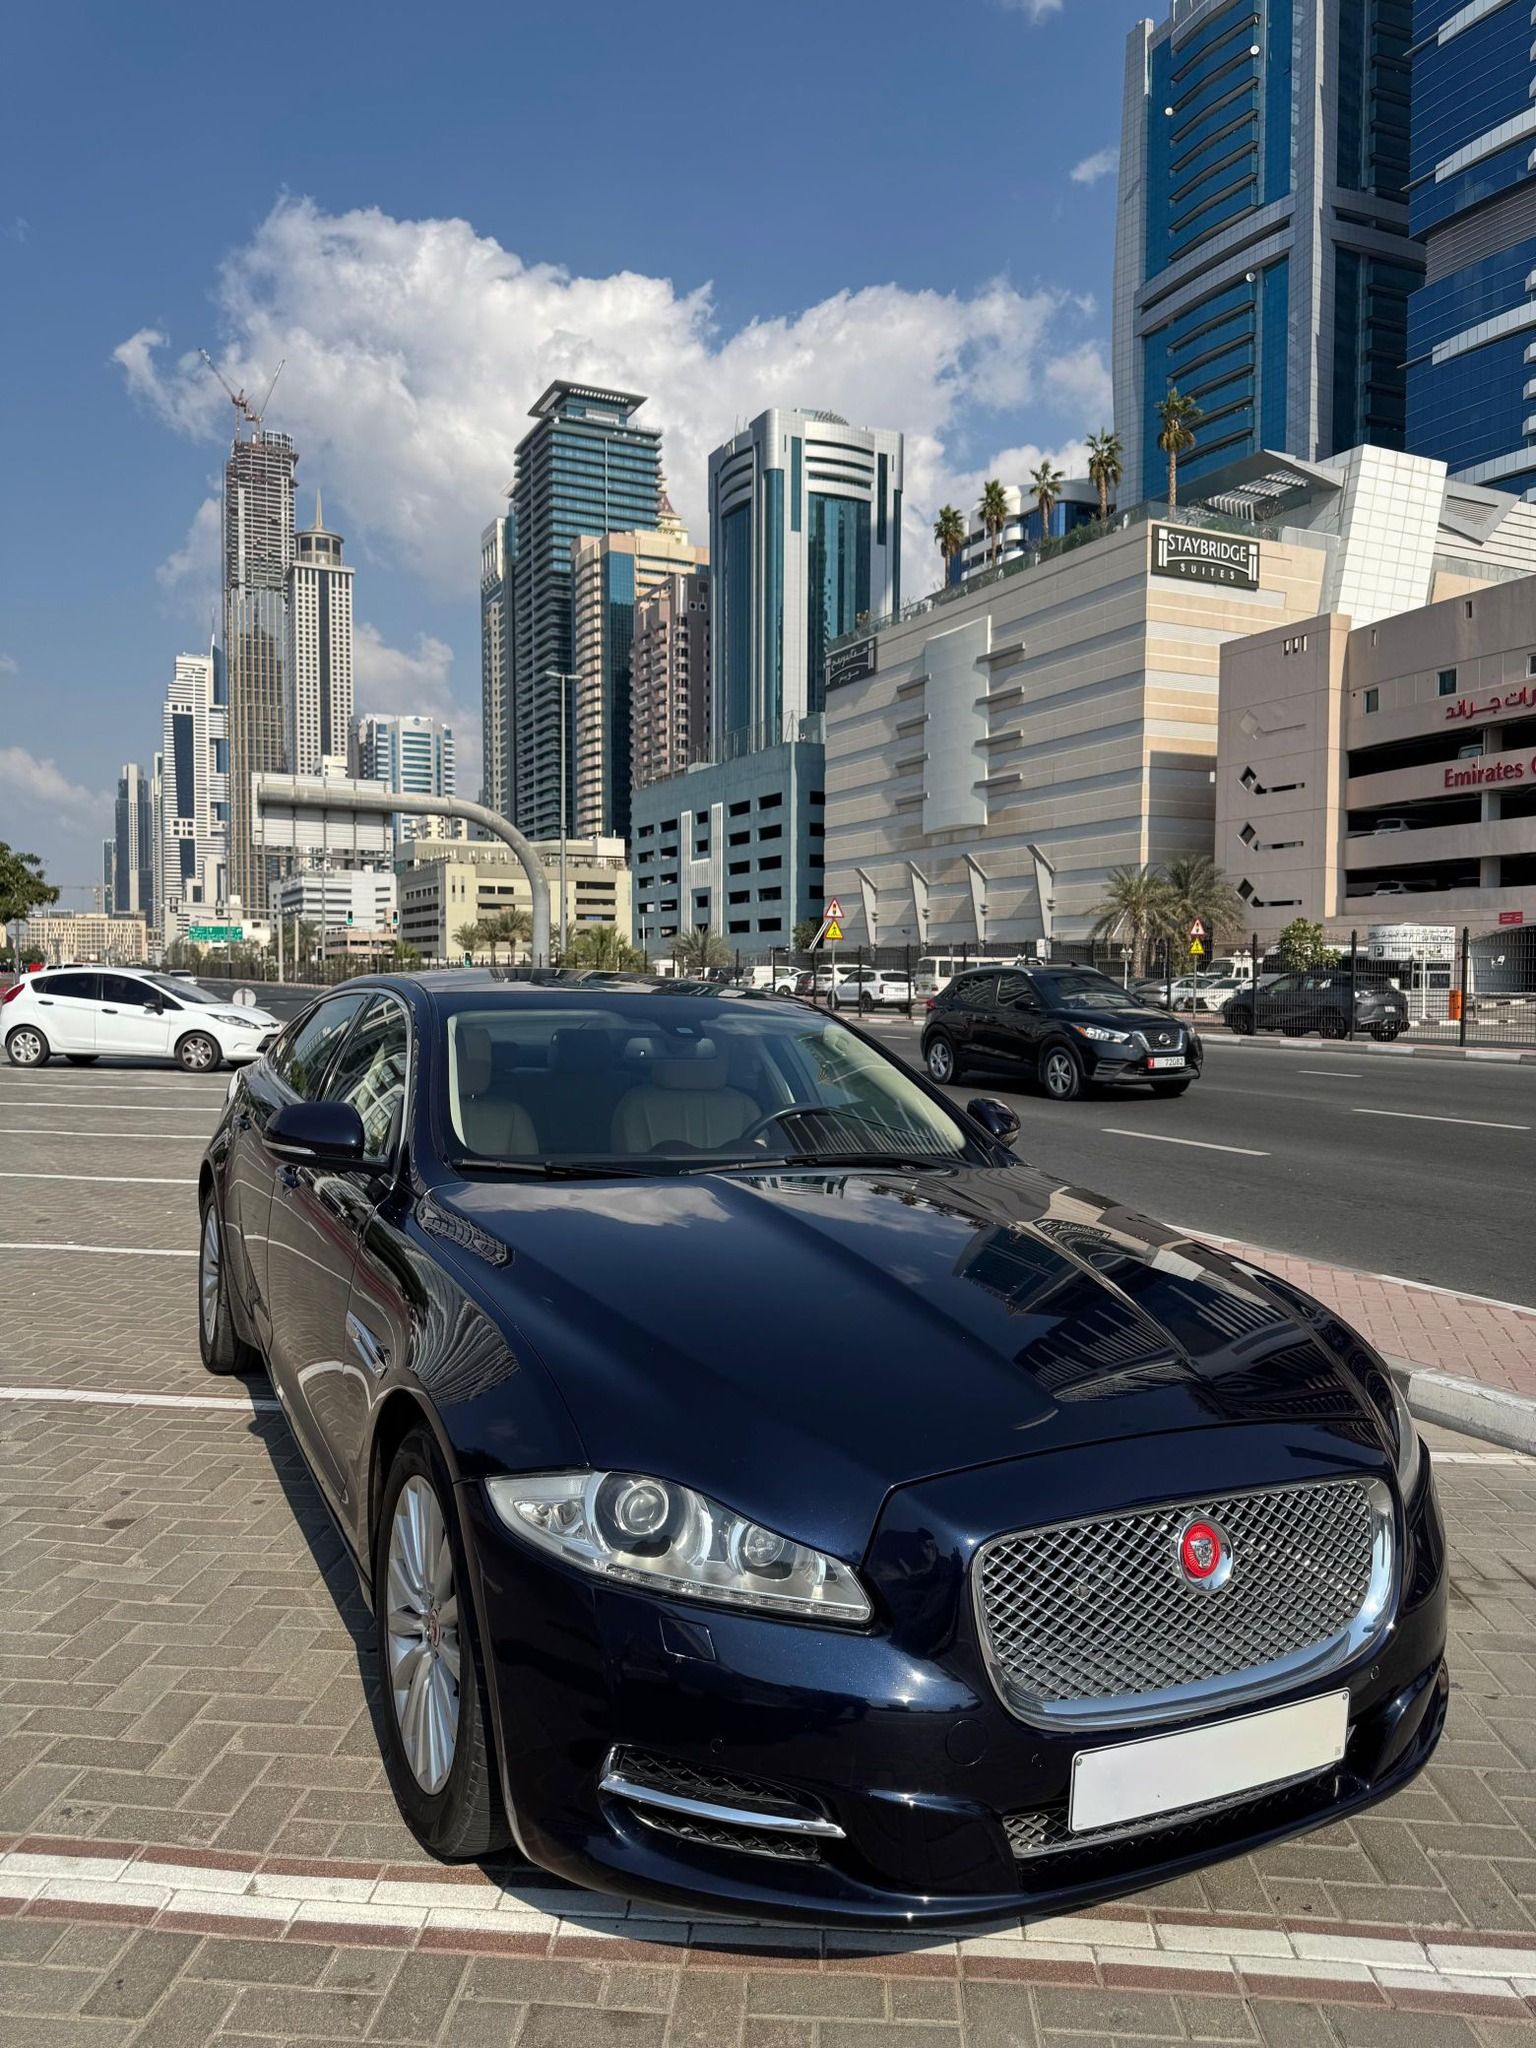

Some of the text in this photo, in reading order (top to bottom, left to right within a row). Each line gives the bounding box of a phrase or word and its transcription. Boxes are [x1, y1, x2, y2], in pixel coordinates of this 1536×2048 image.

[1168, 533, 1247, 562] STAYBRIDGE
[1180, 563, 1235, 580] SUITES
[1446, 697, 1501, 720] جراند
[1444, 761, 1524, 788] Emirates
